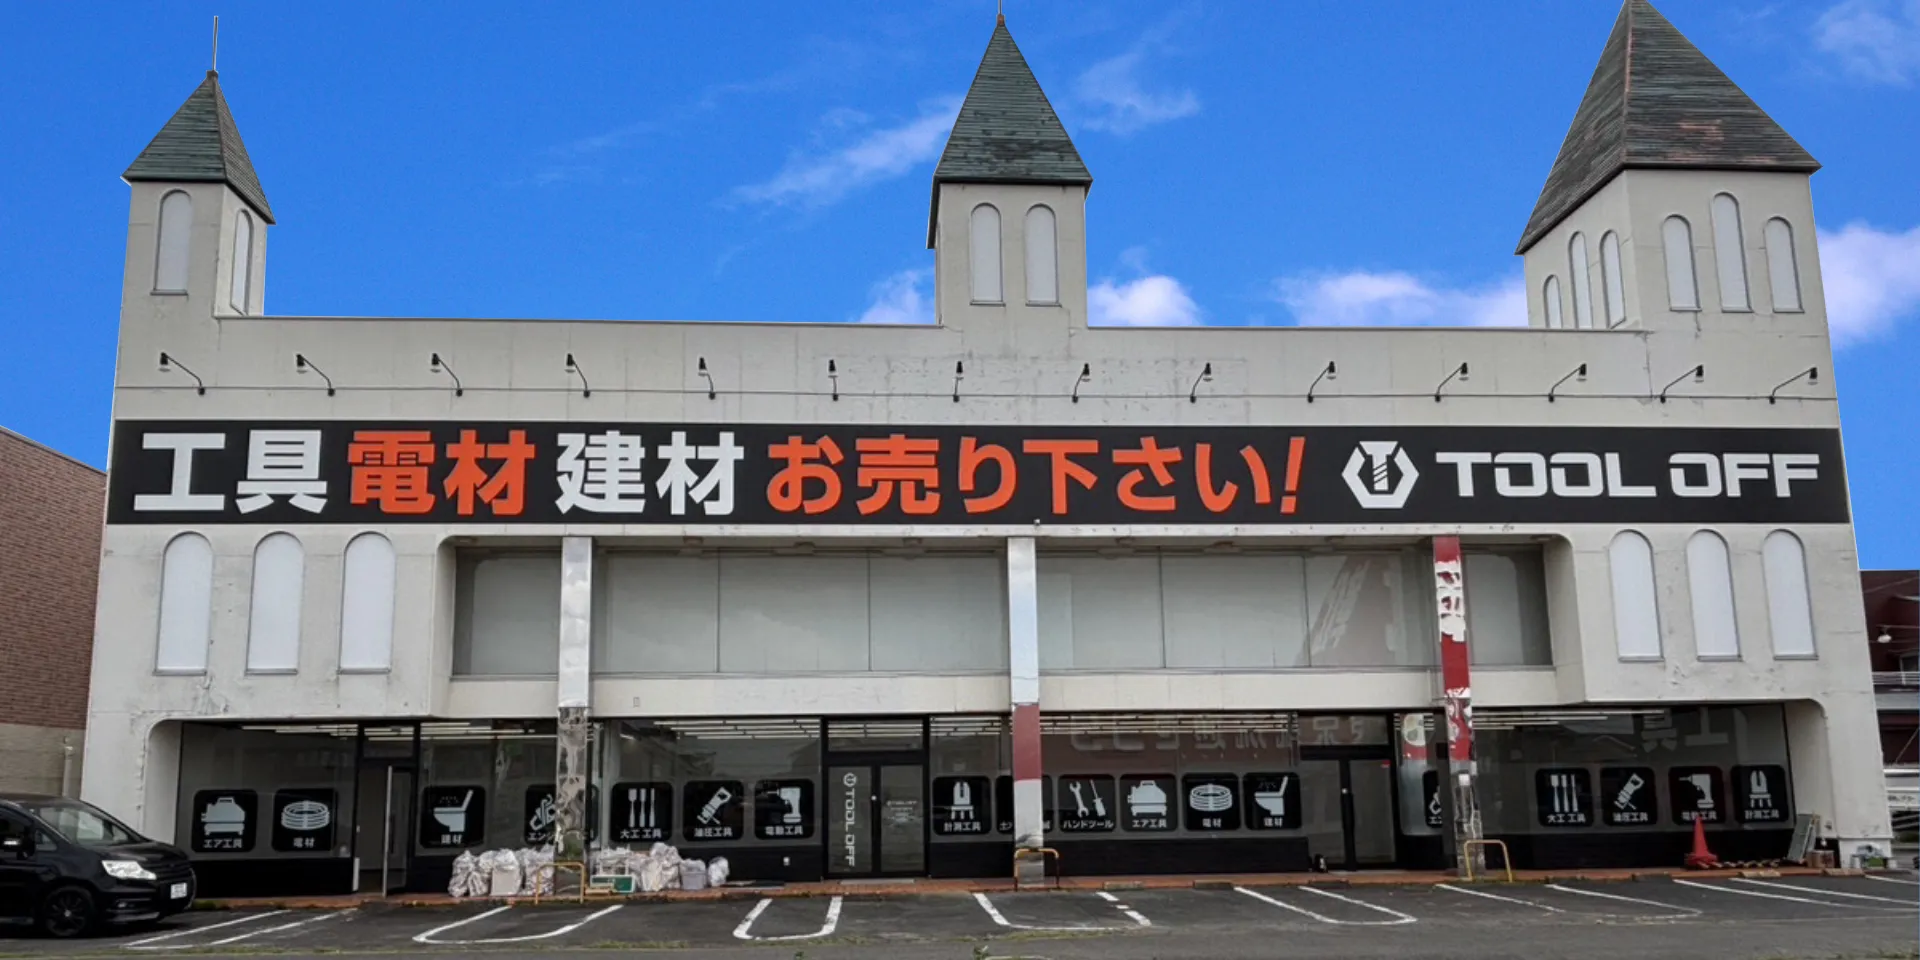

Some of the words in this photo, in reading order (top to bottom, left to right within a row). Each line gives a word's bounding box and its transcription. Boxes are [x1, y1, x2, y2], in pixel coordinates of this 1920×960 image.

[134, 429, 328, 515] 工具
[347, 429, 535, 516] 電材
[555, 430, 744, 516] 建材
[766, 433, 1306, 515] お売り下さい!
[1435, 451, 1657, 498] TOOL
[1668, 452, 1820, 498] OFF
[845, 788, 855, 832] TOOL
[1063, 819, 1114, 829] ハンドツール
[1132, 819, 1167, 828] エア工具
[203, 838, 243, 849] エア工具
[845, 834, 855, 867] OFF
